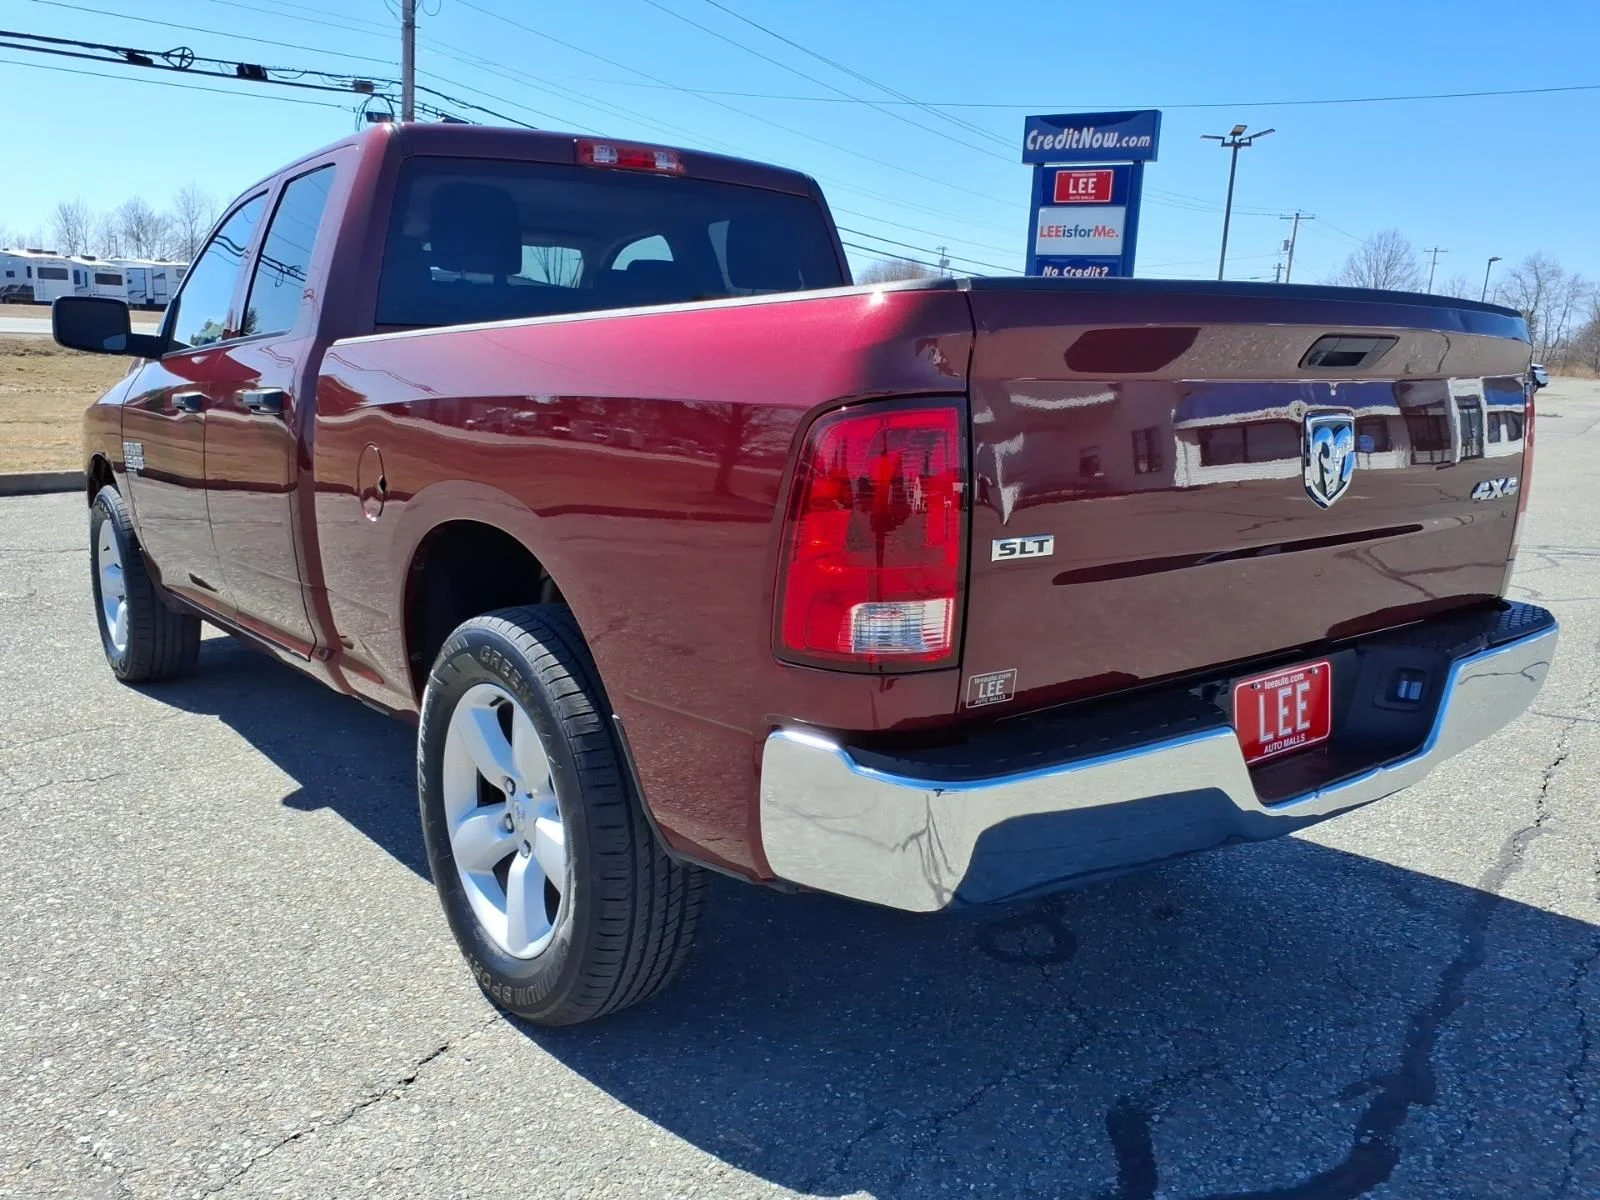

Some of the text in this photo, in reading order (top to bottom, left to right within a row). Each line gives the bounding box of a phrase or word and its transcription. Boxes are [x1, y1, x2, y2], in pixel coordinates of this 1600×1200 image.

[1026, 127, 1151, 150] CreditNow.com
[1069, 178, 1097, 194] LEE
[1042, 265, 1109, 277] No Credit?
[998, 539, 1050, 557] SLT
[979, 679, 1004, 699] LEE
[1264, 673, 1304, 690] leeauto.com
[1259, 680, 1310, 743] LEE
[1264, 733, 1306, 754] AUTO MALLS
